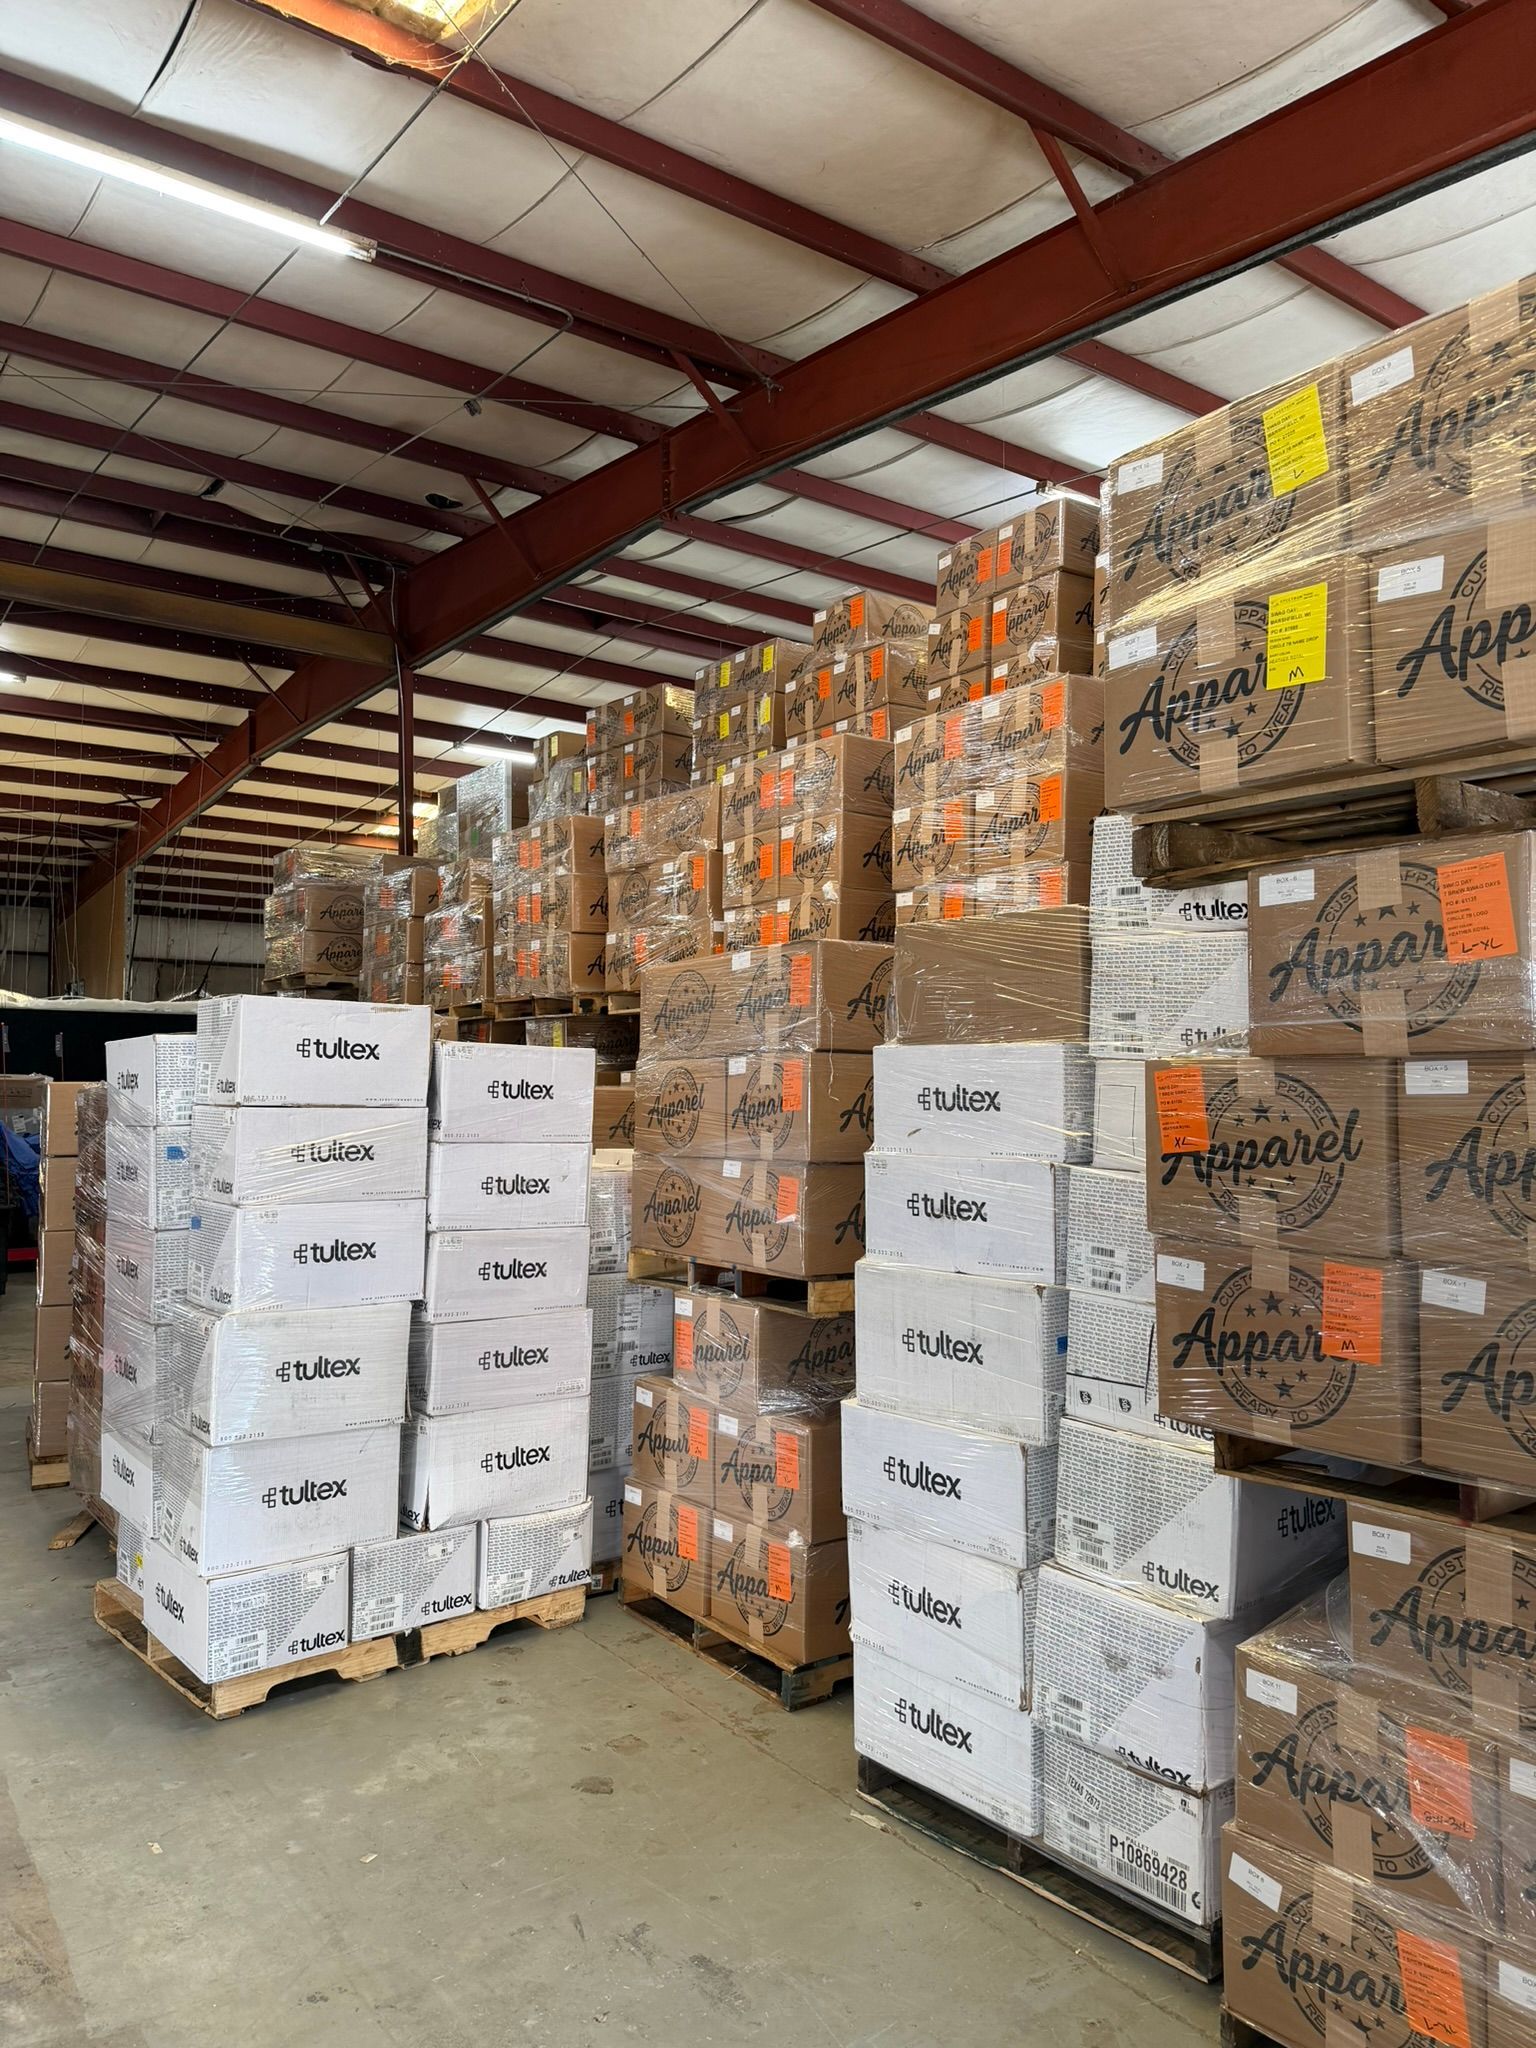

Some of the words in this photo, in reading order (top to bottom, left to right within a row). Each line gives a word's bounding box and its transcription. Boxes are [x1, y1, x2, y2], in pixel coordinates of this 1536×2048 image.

[1124, 468, 1270, 581] Appar
[1008, 592, 1051, 632] pparel
[1288, 666, 1304, 682] M
[1120, 652, 1267, 755] Appar
[320, 904, 364, 921] Appare
[1325, 886, 1358, 923] CUST
[316, 947, 362, 963] Appare
[1269, 919, 1447, 1002] Appar
[315, 1037, 379, 1060] tultex
[220, 1078, 236, 1095] tultex
[500, 1079, 554, 1100] tultex
[933, 1084, 1000, 1112] tultex
[648, 1087, 705, 1129] Apparel
[732, 1090, 783, 1131] Appar
[1277, 1079, 1330, 1127] PPAREL
[310, 1140, 375, 1163] tultex
[495, 1174, 550, 1195] tultex
[643, 1184, 701, 1224] Apparel
[922, 1192, 987, 1222] tultex
[310, 1239, 376, 1263] tultex
[493, 1258, 547, 1280] tultex
[493, 1346, 549, 1368] tultex
[693, 1333, 750, 1365] pparel
[789, 1335, 855, 1375] Appa
[919, 1330, 983, 1365] tultex
[1172, 1307, 1330, 1376] Appar
[1341, 1339, 1357, 1353] M
[293, 1356, 361, 1381] tultex
[638, 1352, 671, 1368] tultex
[1314, 1372, 1347, 1413] WEAR
[117, 1456, 135, 1487] tultex
[495, 1445, 550, 1471] tultex
[720, 1447, 776, 1486] Appa
[279, 1479, 347, 1506] tultex
[898, 1456, 961, 1500] tultex
[1289, 1497, 1336, 1535] tultex
[1372, 1530, 1385, 1538] BOX
[183, 1539, 199, 1565] tultex
[558, 1567, 592, 1587] tultex
[717, 1556, 769, 1602] Appa
[1156, 1562, 1219, 1603] tultex
[1428, 1555, 1464, 1588] CUST
[161, 1584, 185, 1624] tultex
[432, 1593, 472, 1615] tultex
[901, 1584, 961, 1630] tultex
[300, 1628, 345, 1653] tultex
[1369, 1585, 1536, 1668] Appa
[907, 1701, 972, 1754] tultex
[1303, 1711, 1336, 1738] CUST
[1068, 1775, 1084, 1796] TEXAS
[1125, 1836, 1149, 1852] PALLET
[1110, 1834, 1187, 1891] P10869428
[1241, 1920, 1407, 2015] Appar
